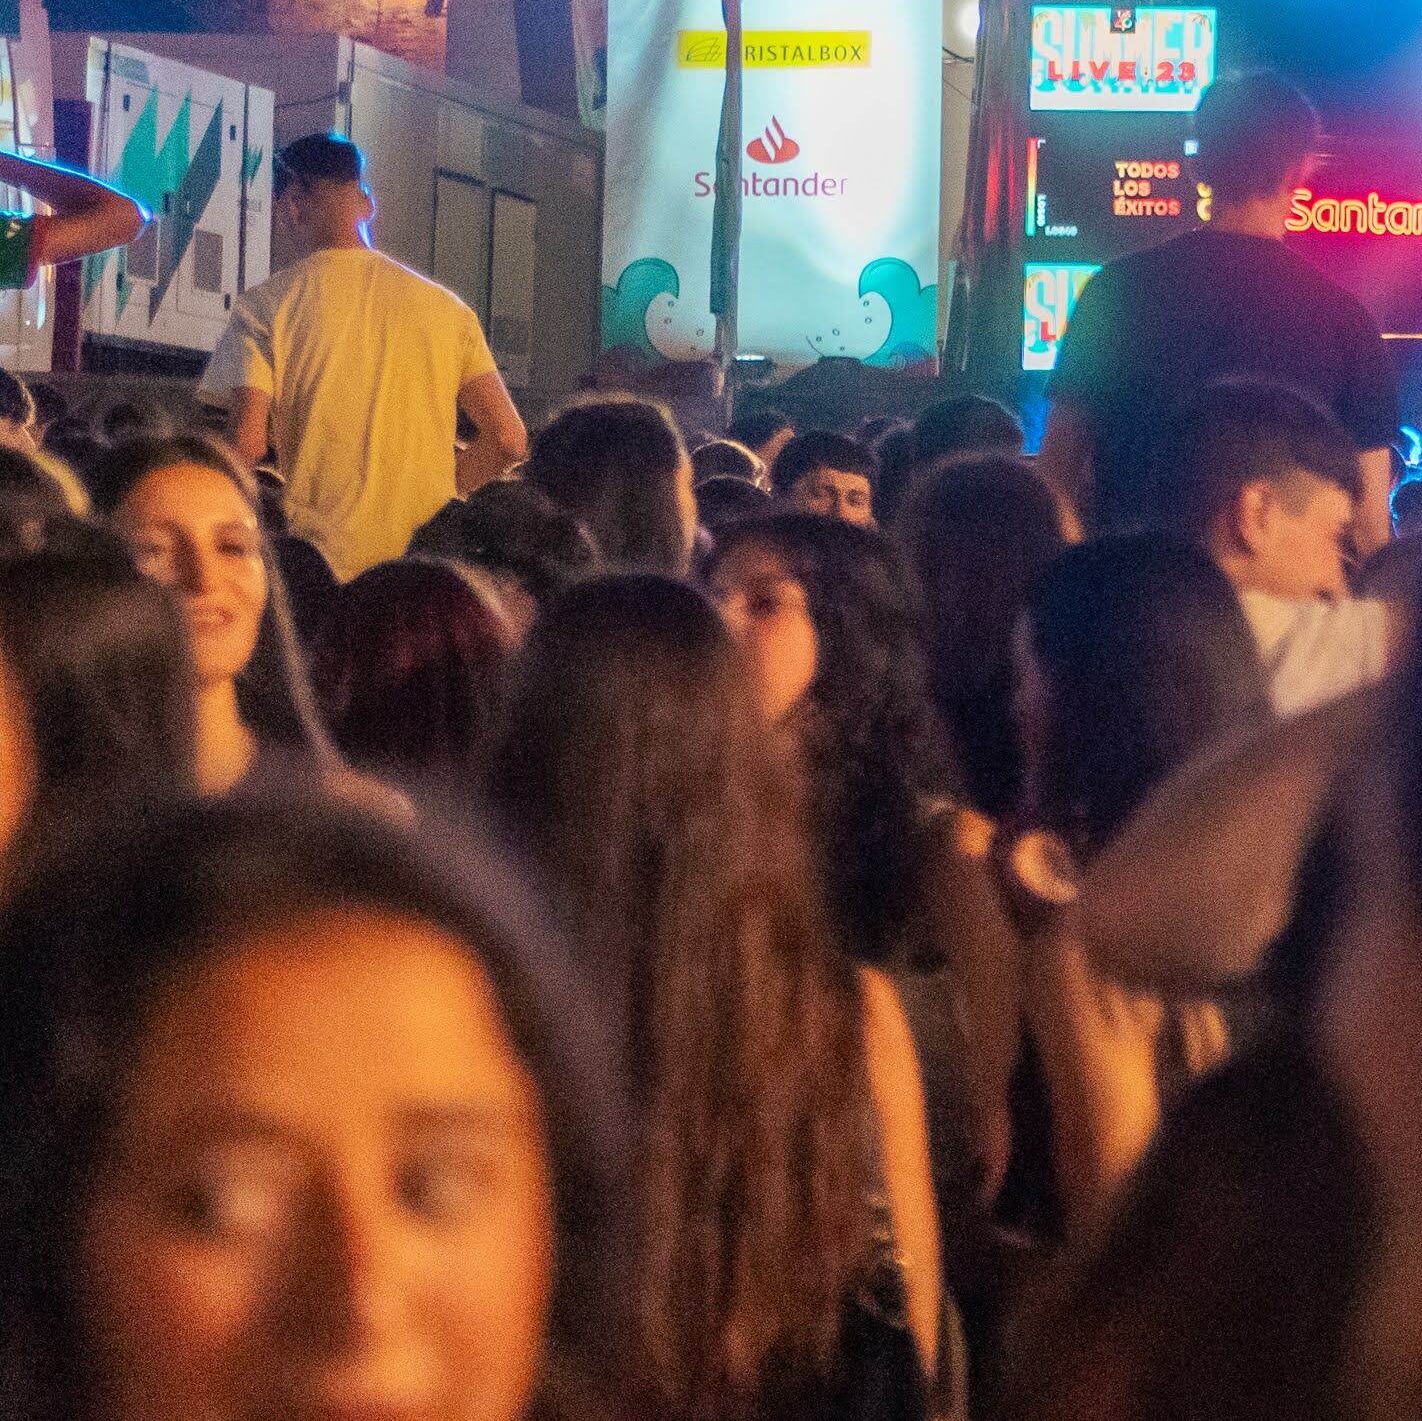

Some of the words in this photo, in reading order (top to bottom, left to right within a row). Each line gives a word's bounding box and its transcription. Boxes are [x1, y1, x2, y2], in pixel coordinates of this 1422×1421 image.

[744, 44, 862, 62] RISTALBOX
[1032, 9, 1212, 85] SUMMER
[1047, 60, 1136, 82] LIVE
[1114, 160, 1181, 179] TODOS
[1112, 180, 1152, 197] LOS
[1112, 196, 1181, 217] ÉXITOS
